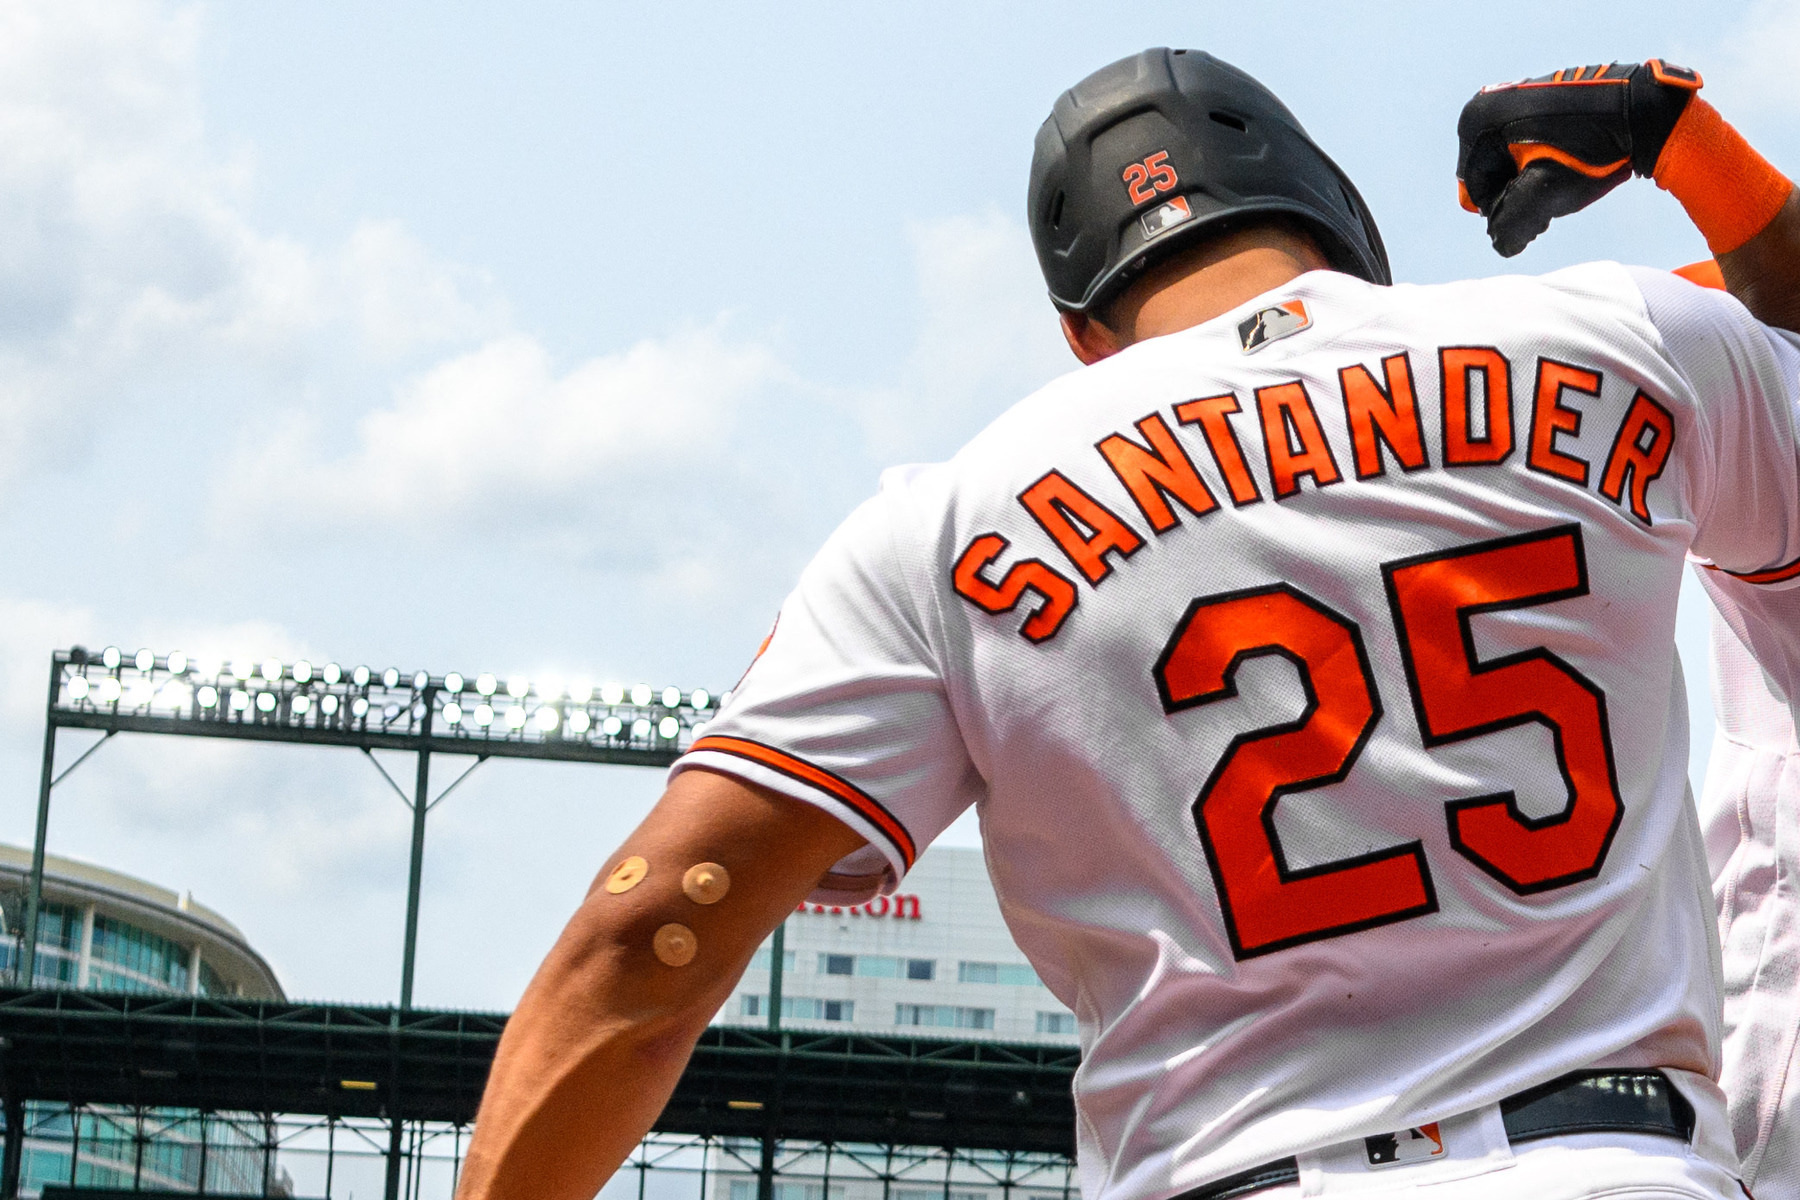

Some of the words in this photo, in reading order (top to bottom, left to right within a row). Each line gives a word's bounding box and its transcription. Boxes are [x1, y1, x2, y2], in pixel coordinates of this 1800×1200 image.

[1122, 150, 1179, 205] 25
[951, 345, 1676, 645] SANTANDER
[1152, 522, 1625, 962] 25
